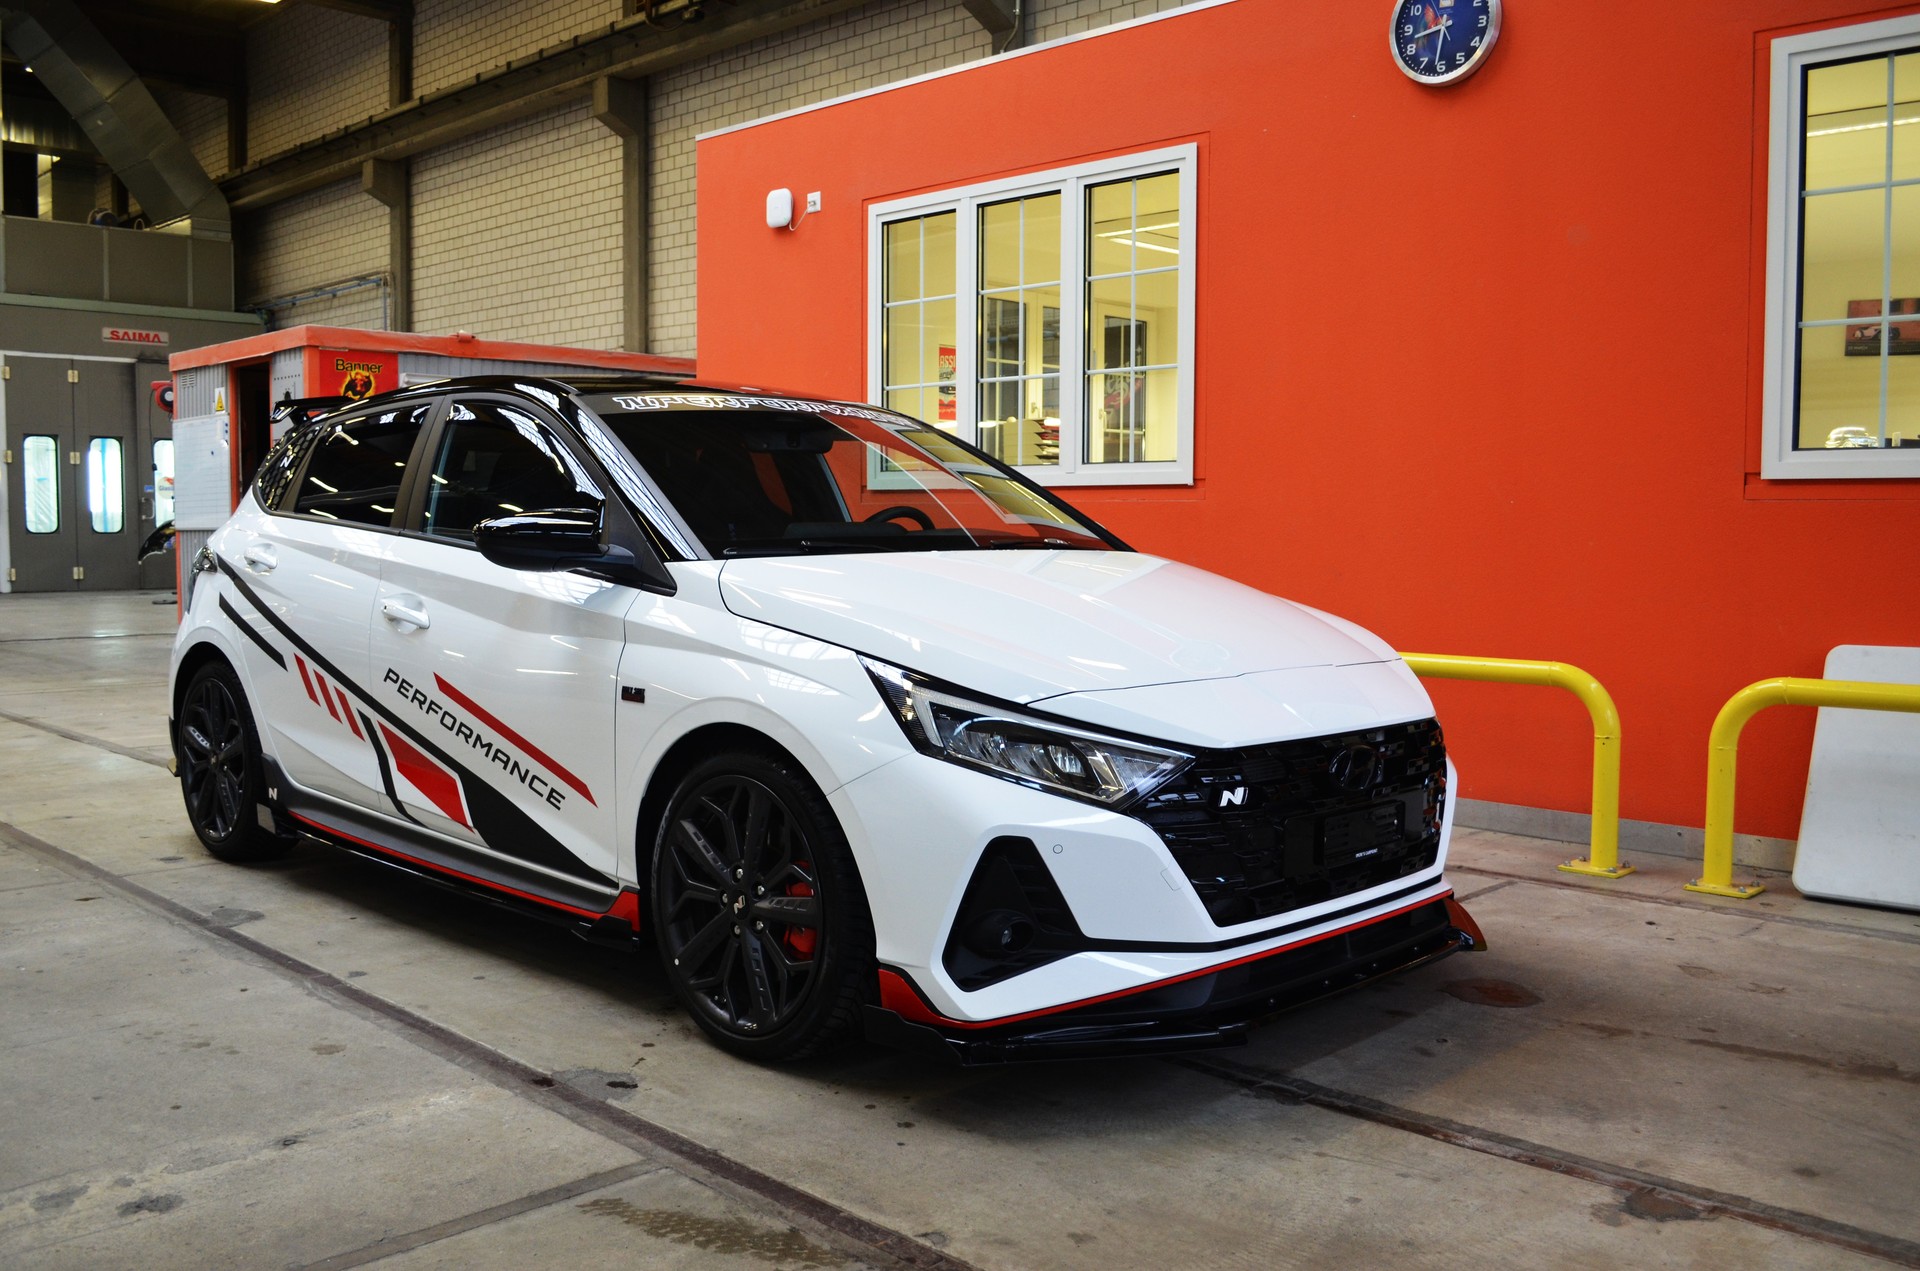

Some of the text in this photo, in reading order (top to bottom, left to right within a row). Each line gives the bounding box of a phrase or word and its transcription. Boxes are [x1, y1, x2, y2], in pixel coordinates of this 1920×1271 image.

[1410, 4, 1422, 17] 10
[1478, 15, 1488, 27] 3
[1404, 24, 1413, 36] 9
[1470, 36, 1480, 47] 4
[1406, 44, 1416, 55] 8
[1420, 57, 1429, 69] 7
[1455, 52, 1466, 64] 5
[1436, 60, 1446, 72] 6
[110, 329, 162, 344] SAIMA
[335, 358, 383, 374] Banner
[383, 667, 567, 811] PERFORMANCE
[268, 787, 278, 801] N
[1219, 786, 1248, 807] N
